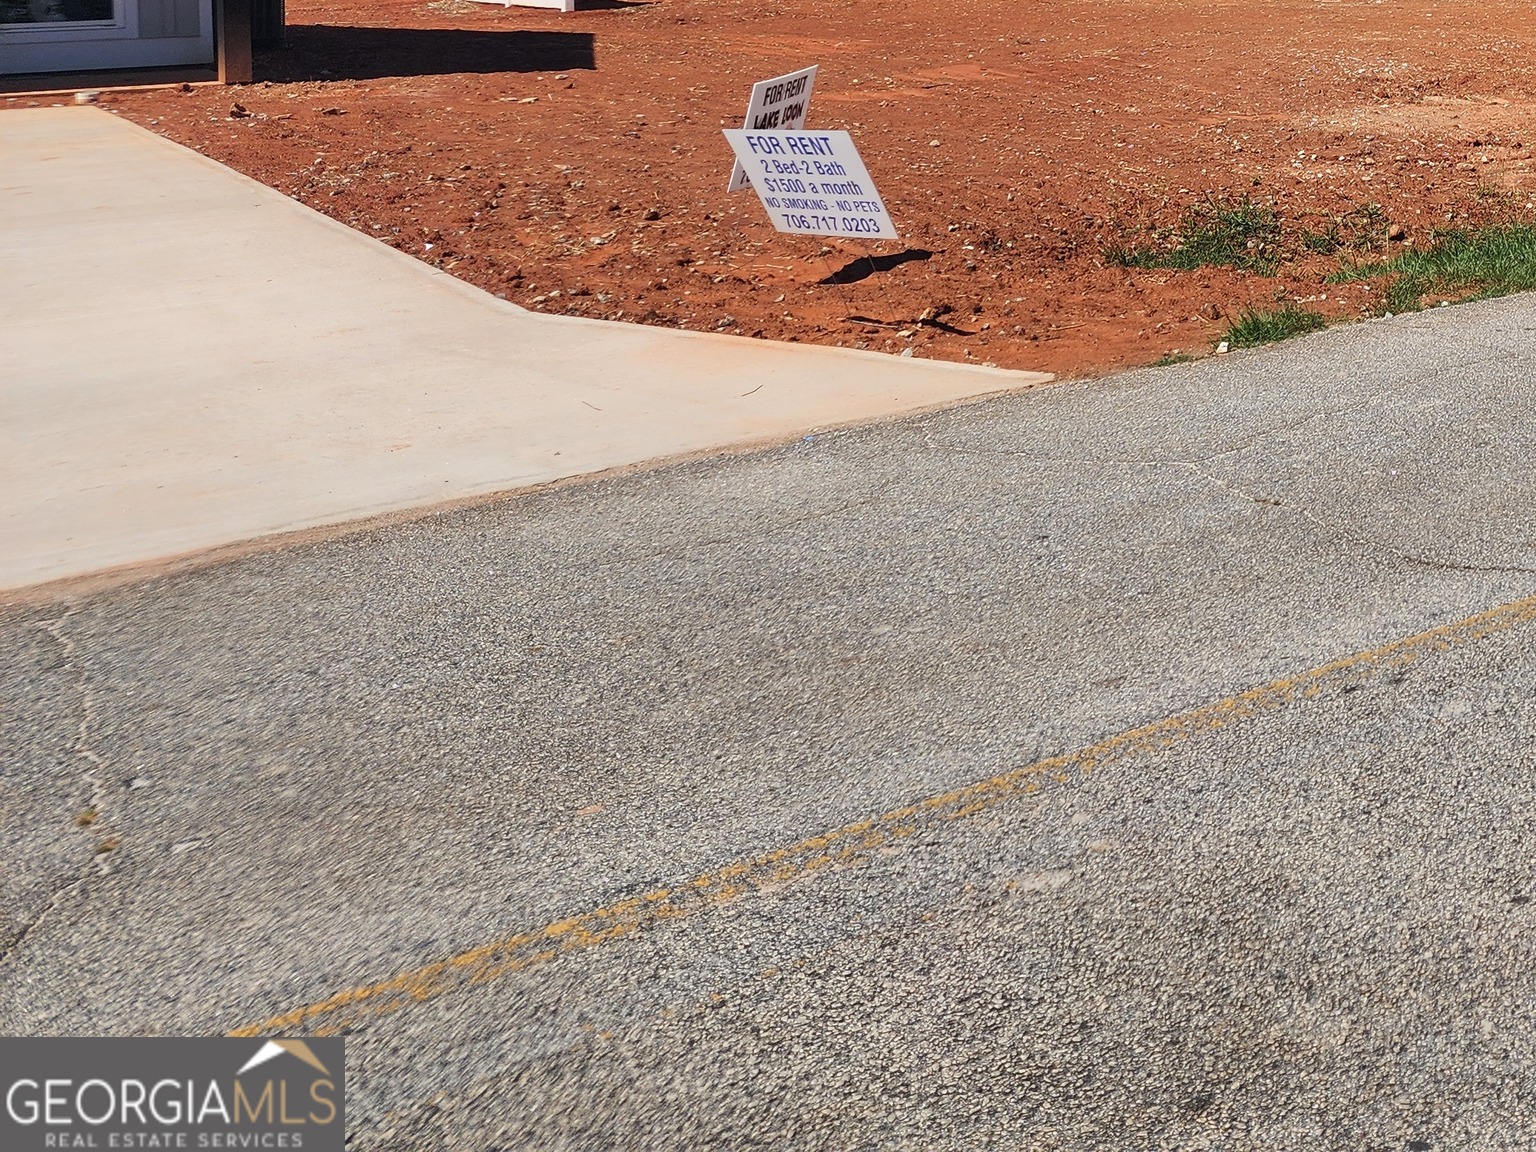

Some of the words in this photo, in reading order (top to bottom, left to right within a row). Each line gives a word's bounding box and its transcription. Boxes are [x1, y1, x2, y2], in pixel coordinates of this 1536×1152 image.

[763, 83, 784, 106] FOR
[784, 75, 809, 101] RENT
[753, 109, 780, 130] LAKE
[782, 100, 805, 124] LOON
[746, 135, 786, 154] FOR
[786, 136, 834, 155] RENT
[761, 159, 773, 174] 2
[772, 159, 812, 176] Bed-2
[815, 160, 847, 177] Bath
[764, 177, 807, 194] $1500
[809, 182, 819, 194] a
[822, 180, 863, 195] month
[765, 197, 781, 209] NO
[783, 198, 829, 211] SMOKING
[836, 200, 852, 212] NO
[853, 201, 881, 213] PETS
[781, 213, 881, 234] 706.717.0203
